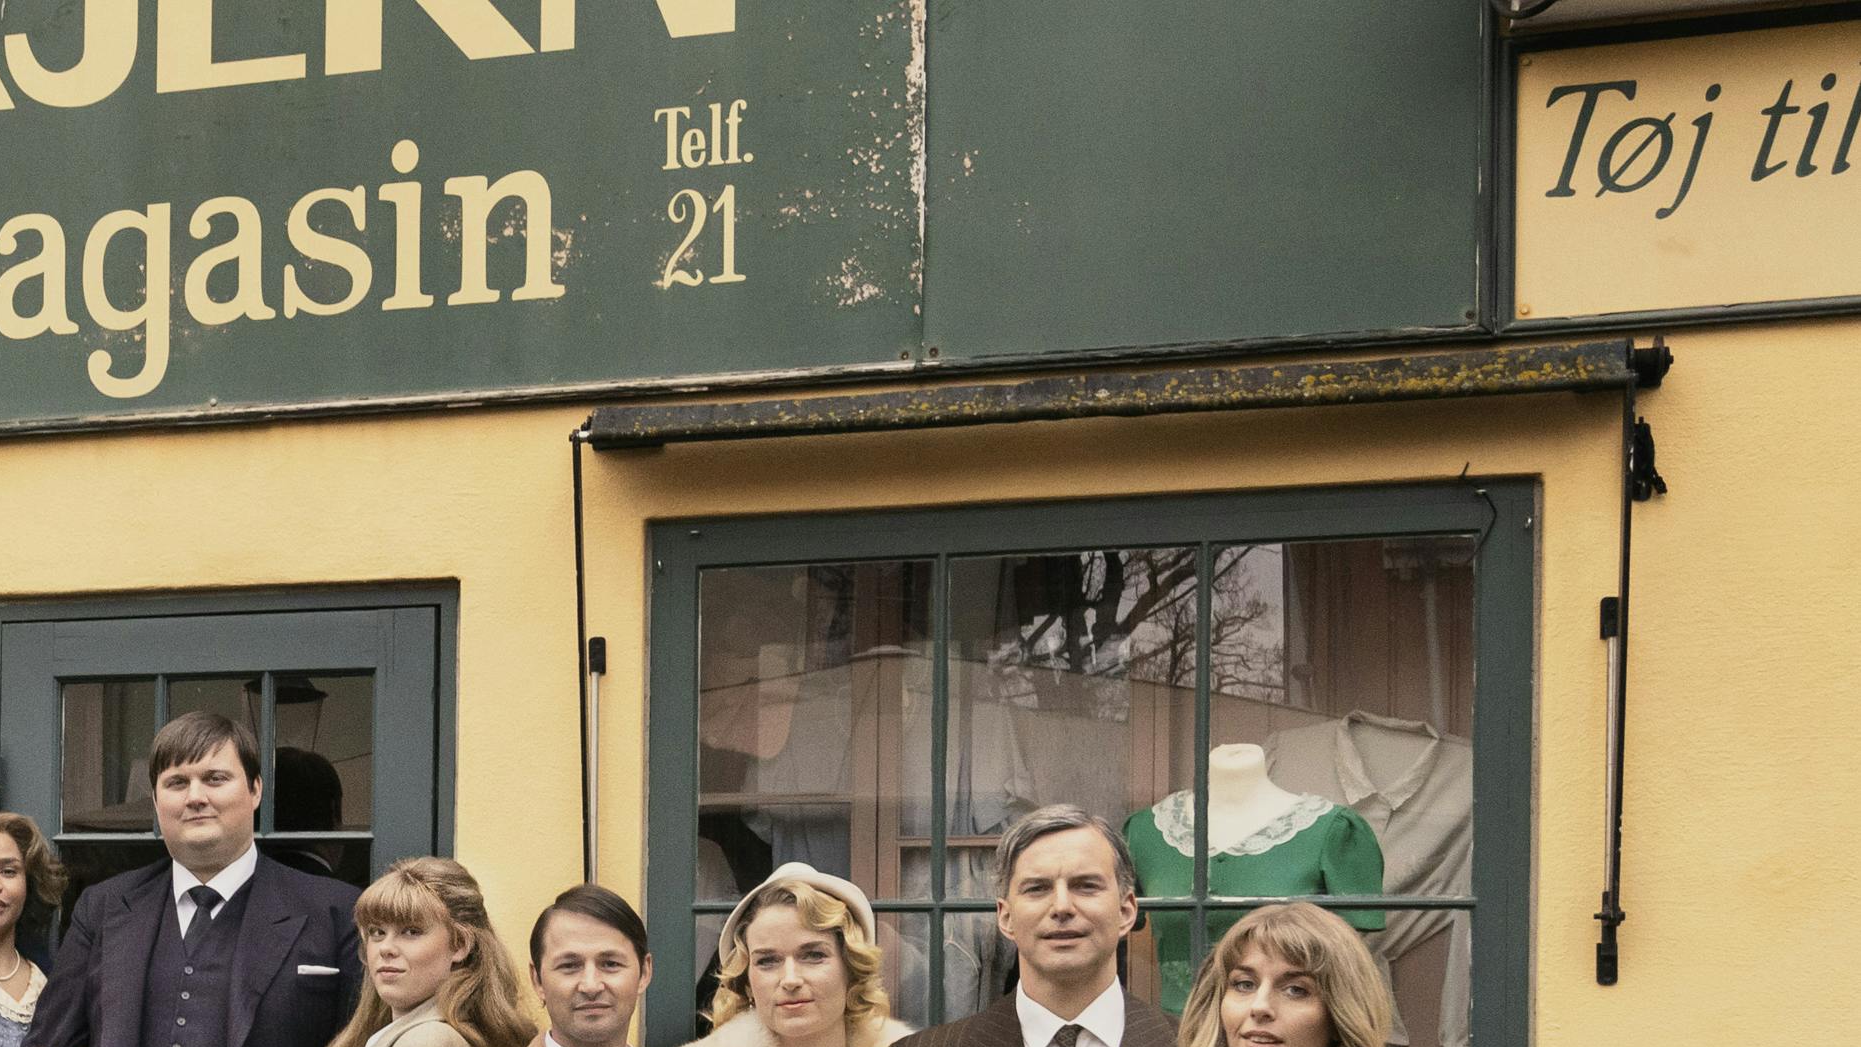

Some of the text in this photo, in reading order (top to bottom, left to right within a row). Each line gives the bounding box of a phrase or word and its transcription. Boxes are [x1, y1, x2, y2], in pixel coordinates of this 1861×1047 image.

[654, 99, 754, 170] Telf.
[1545, 80, 1721, 219] Tøj
[663, 185, 747, 290] 21
